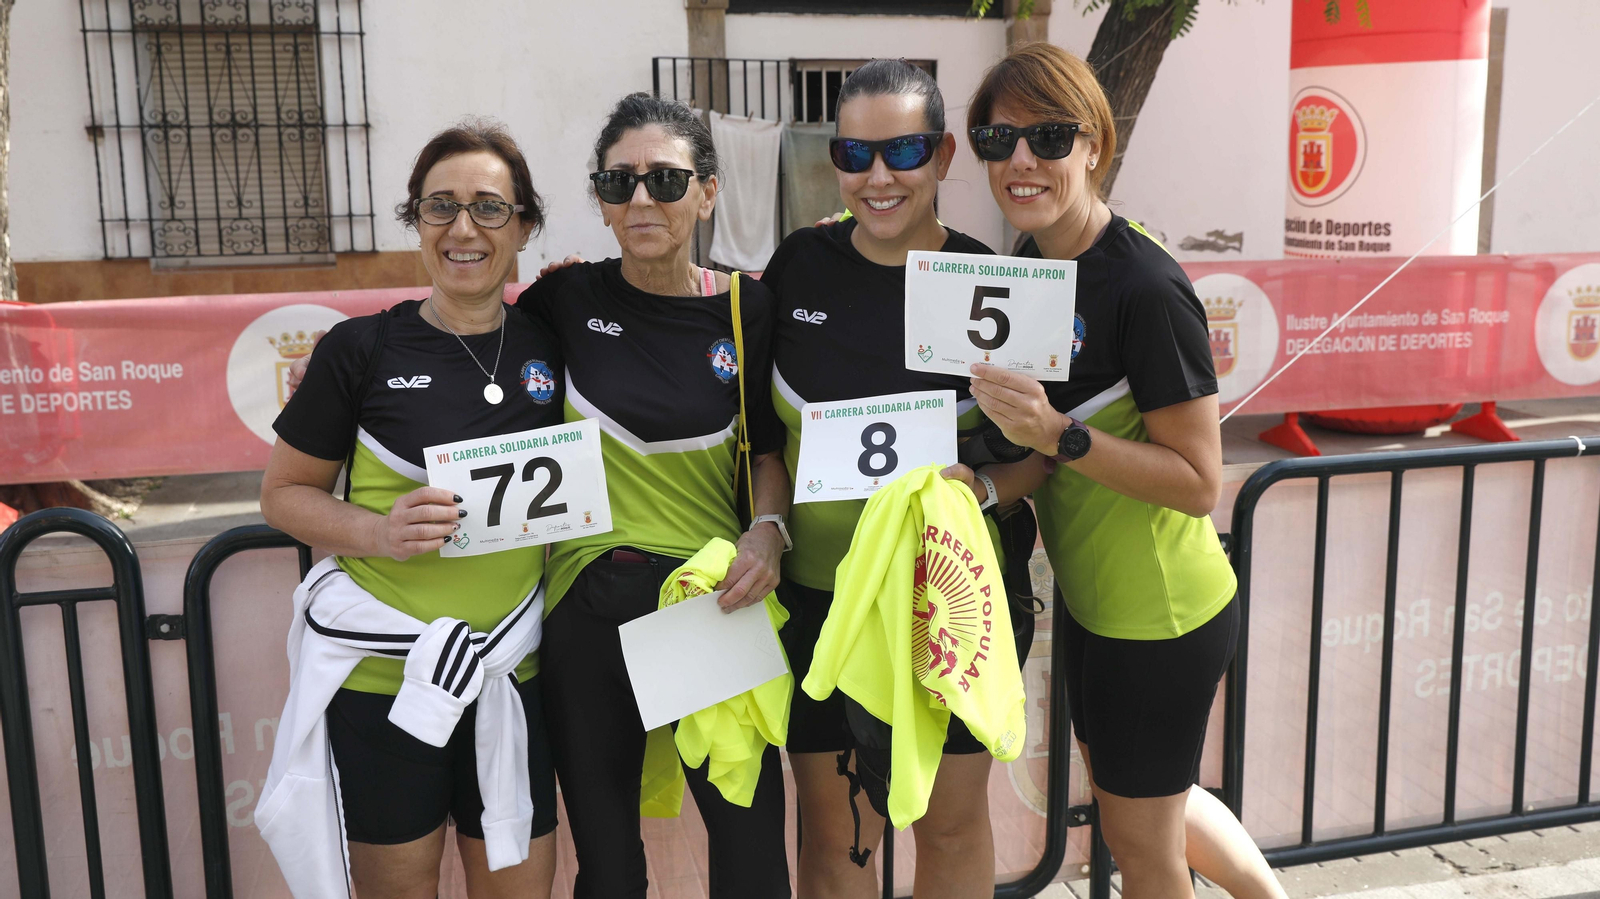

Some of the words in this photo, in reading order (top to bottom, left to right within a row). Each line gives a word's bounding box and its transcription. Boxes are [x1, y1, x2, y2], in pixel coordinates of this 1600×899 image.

[1309, 218, 1322, 235] de
[1325, 219, 1391, 237] Deportes
[1325, 239, 1335, 251] de
[1338, 240, 1356, 252] San
[1358, 240, 1391, 253] Roque
[918, 260, 930, 271] VII
[932, 261, 976, 275] CARRERA
[978, 265, 1029, 278] SOLIDARIA
[1031, 268, 1066, 280] APRON
[966, 285, 1011, 351] 5
[1286, 314, 1327, 331] Ilustre
[1330, 312, 1419, 333] Ayuntamiento
[1421, 310, 1438, 326] de
[1440, 308, 1466, 325] San
[1468, 308, 1510, 326] Roque
[1286, 333, 1375, 355] DELEGACIÓN
[1378, 335, 1397, 351] DE
[1400, 332, 1473, 351] DEPORTES
[48, 362, 74, 383] de
[78, 361, 116, 382] San
[121, 360, 183, 384] Roque
[20, 390, 133, 414] DEPORTES
[811, 411, 822, 420] VII
[824, 406, 864, 419] CARRERA
[866, 401, 911, 415] SOLIDARIA
[914, 398, 944, 410] APRON
[437, 453, 450, 464] VII
[452, 445, 497, 462] CARRERA
[499, 437, 549, 454] SOLIDARIA
[551, 430, 583, 445] APRON
[857, 421, 898, 477] 8
[469, 456, 568, 528] 72
[958, 584, 993, 693] POPULAR
